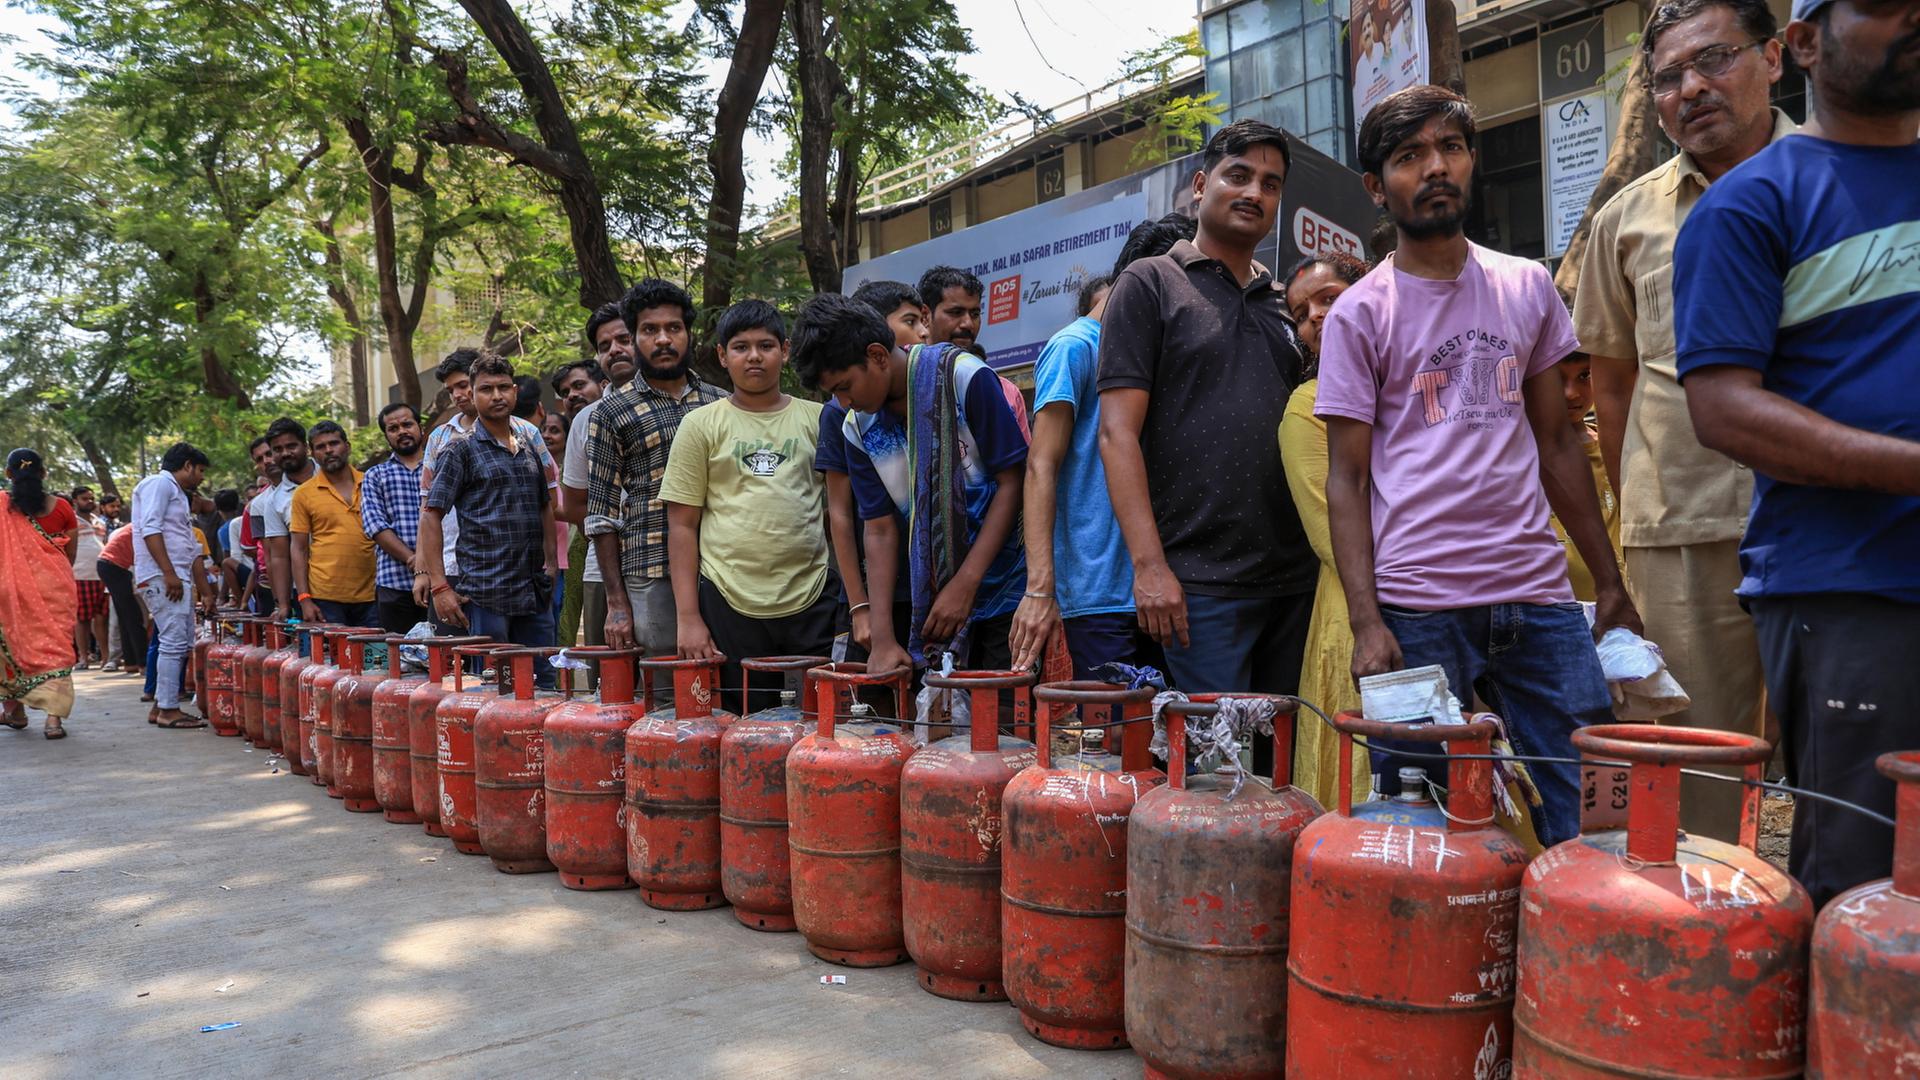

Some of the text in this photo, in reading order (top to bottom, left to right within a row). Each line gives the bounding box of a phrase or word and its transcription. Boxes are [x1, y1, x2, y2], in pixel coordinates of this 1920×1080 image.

[1556, 39, 1591, 78] 60
[1559, 99, 1589, 121] CA
[1561, 118, 1588, 129] INDIA
[1043, 169, 1063, 196] 62
[1302, 215, 1357, 256] BEST
[974, 264, 991, 277] TAK.
[992, 259, 1008, 272] KAL
[1009, 253, 1021, 267] KA
[1023, 244, 1051, 263] SAFAR
[1053, 226, 1111, 255] RETIREMENT
[993, 278, 1016, 296] nps
[1430, 335, 1462, 366] BEST
